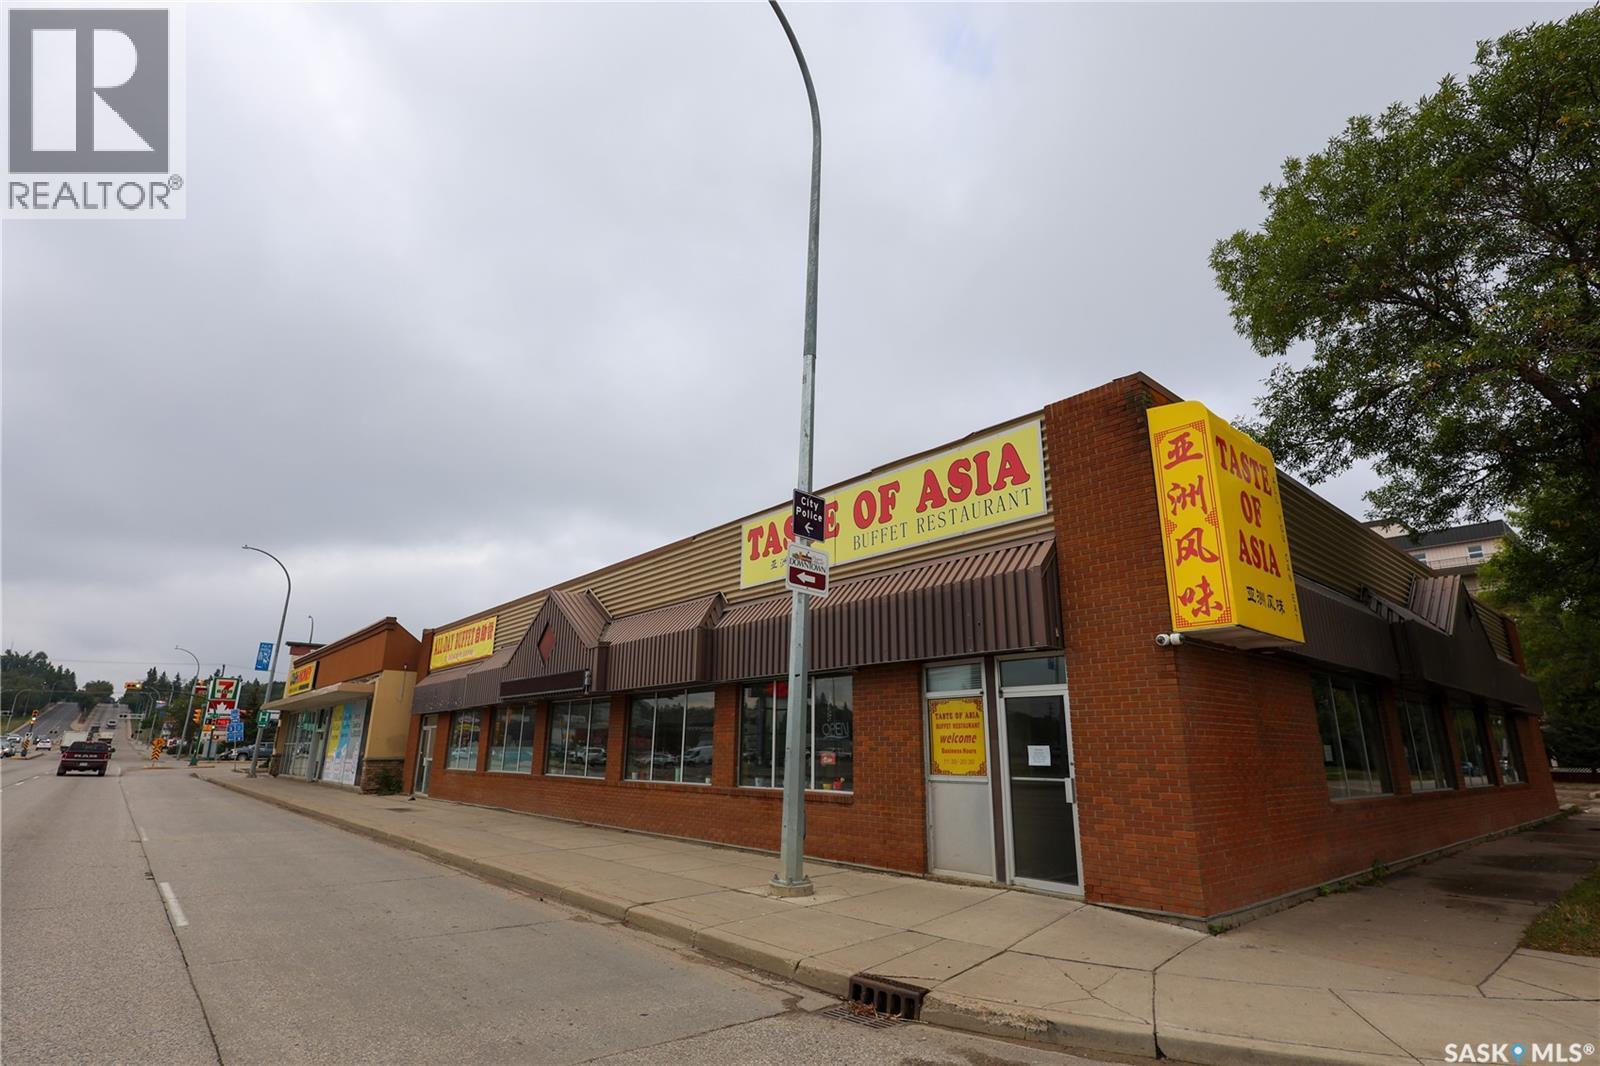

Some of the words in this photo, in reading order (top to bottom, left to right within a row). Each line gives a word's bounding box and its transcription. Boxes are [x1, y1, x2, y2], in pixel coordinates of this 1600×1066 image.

[1215, 435, 1272, 497] TASTE
[853, 480, 900, 530] OF
[915, 442, 1031, 513] ASIA
[795, 506, 823, 523] Police
[800, 496, 819, 512] City
[1239, 490, 1262, 529] OF
[853, 520, 908, 551] BUFFET
[916, 486, 1032, 534] RESTAURANT
[1164, 431, 1224, 617] 亚洲风味
[1238, 529, 1282, 578] ASIA
[259, 711, 269, 722] H
[823, 721, 849, 737] OPEN
[935, 712, 953, 720] TASTE
[954, 712, 963, 720] OF
[965, 711, 980, 719] ASIA
[940, 732, 977, 744] welcome
